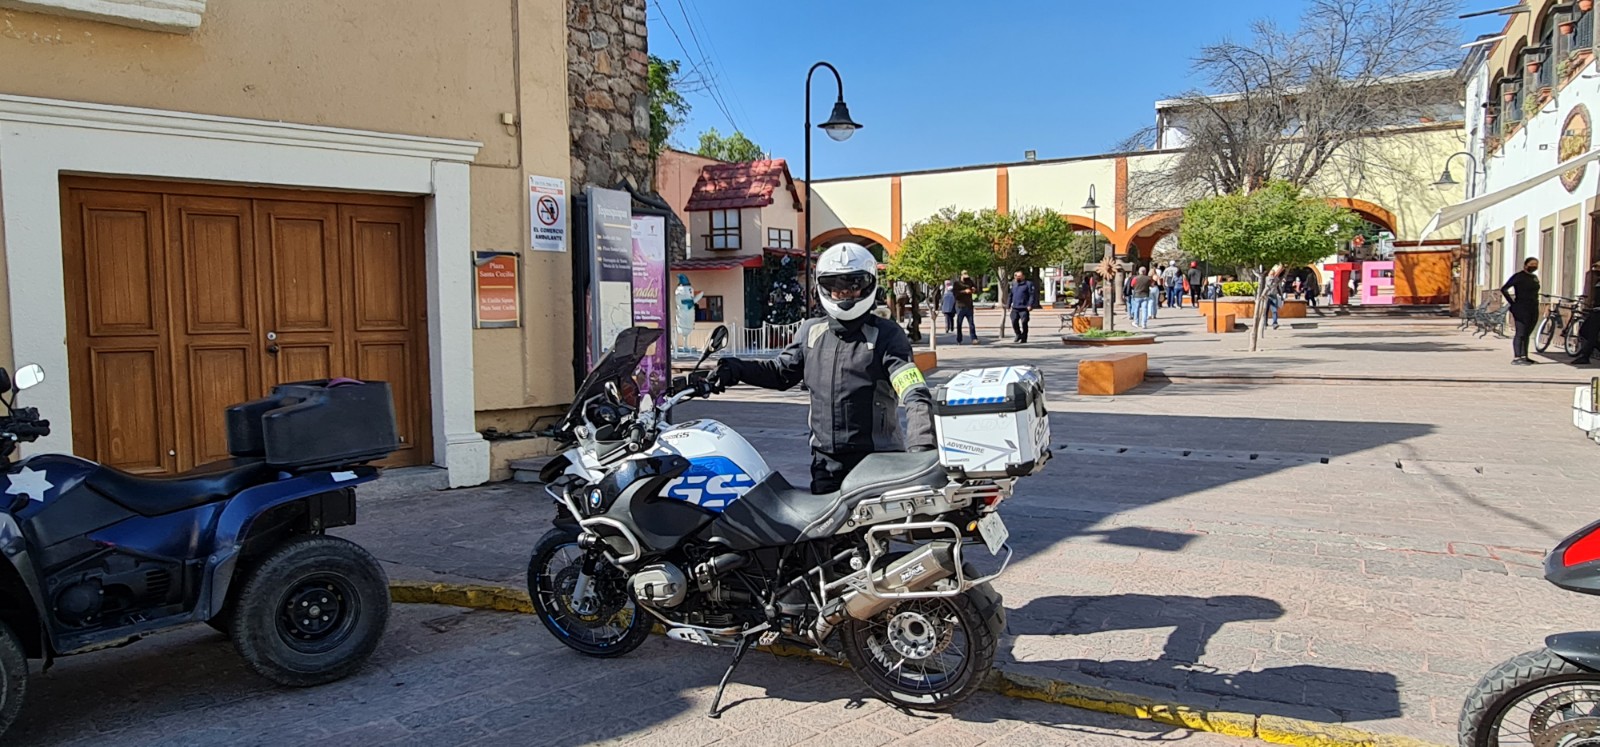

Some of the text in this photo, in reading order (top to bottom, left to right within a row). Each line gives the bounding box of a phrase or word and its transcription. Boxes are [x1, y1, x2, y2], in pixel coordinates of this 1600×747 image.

[946, 441, 984, 454] ADVENTURE
[658, 473, 753, 507] GS
[867, 634, 894, 672] BMW
